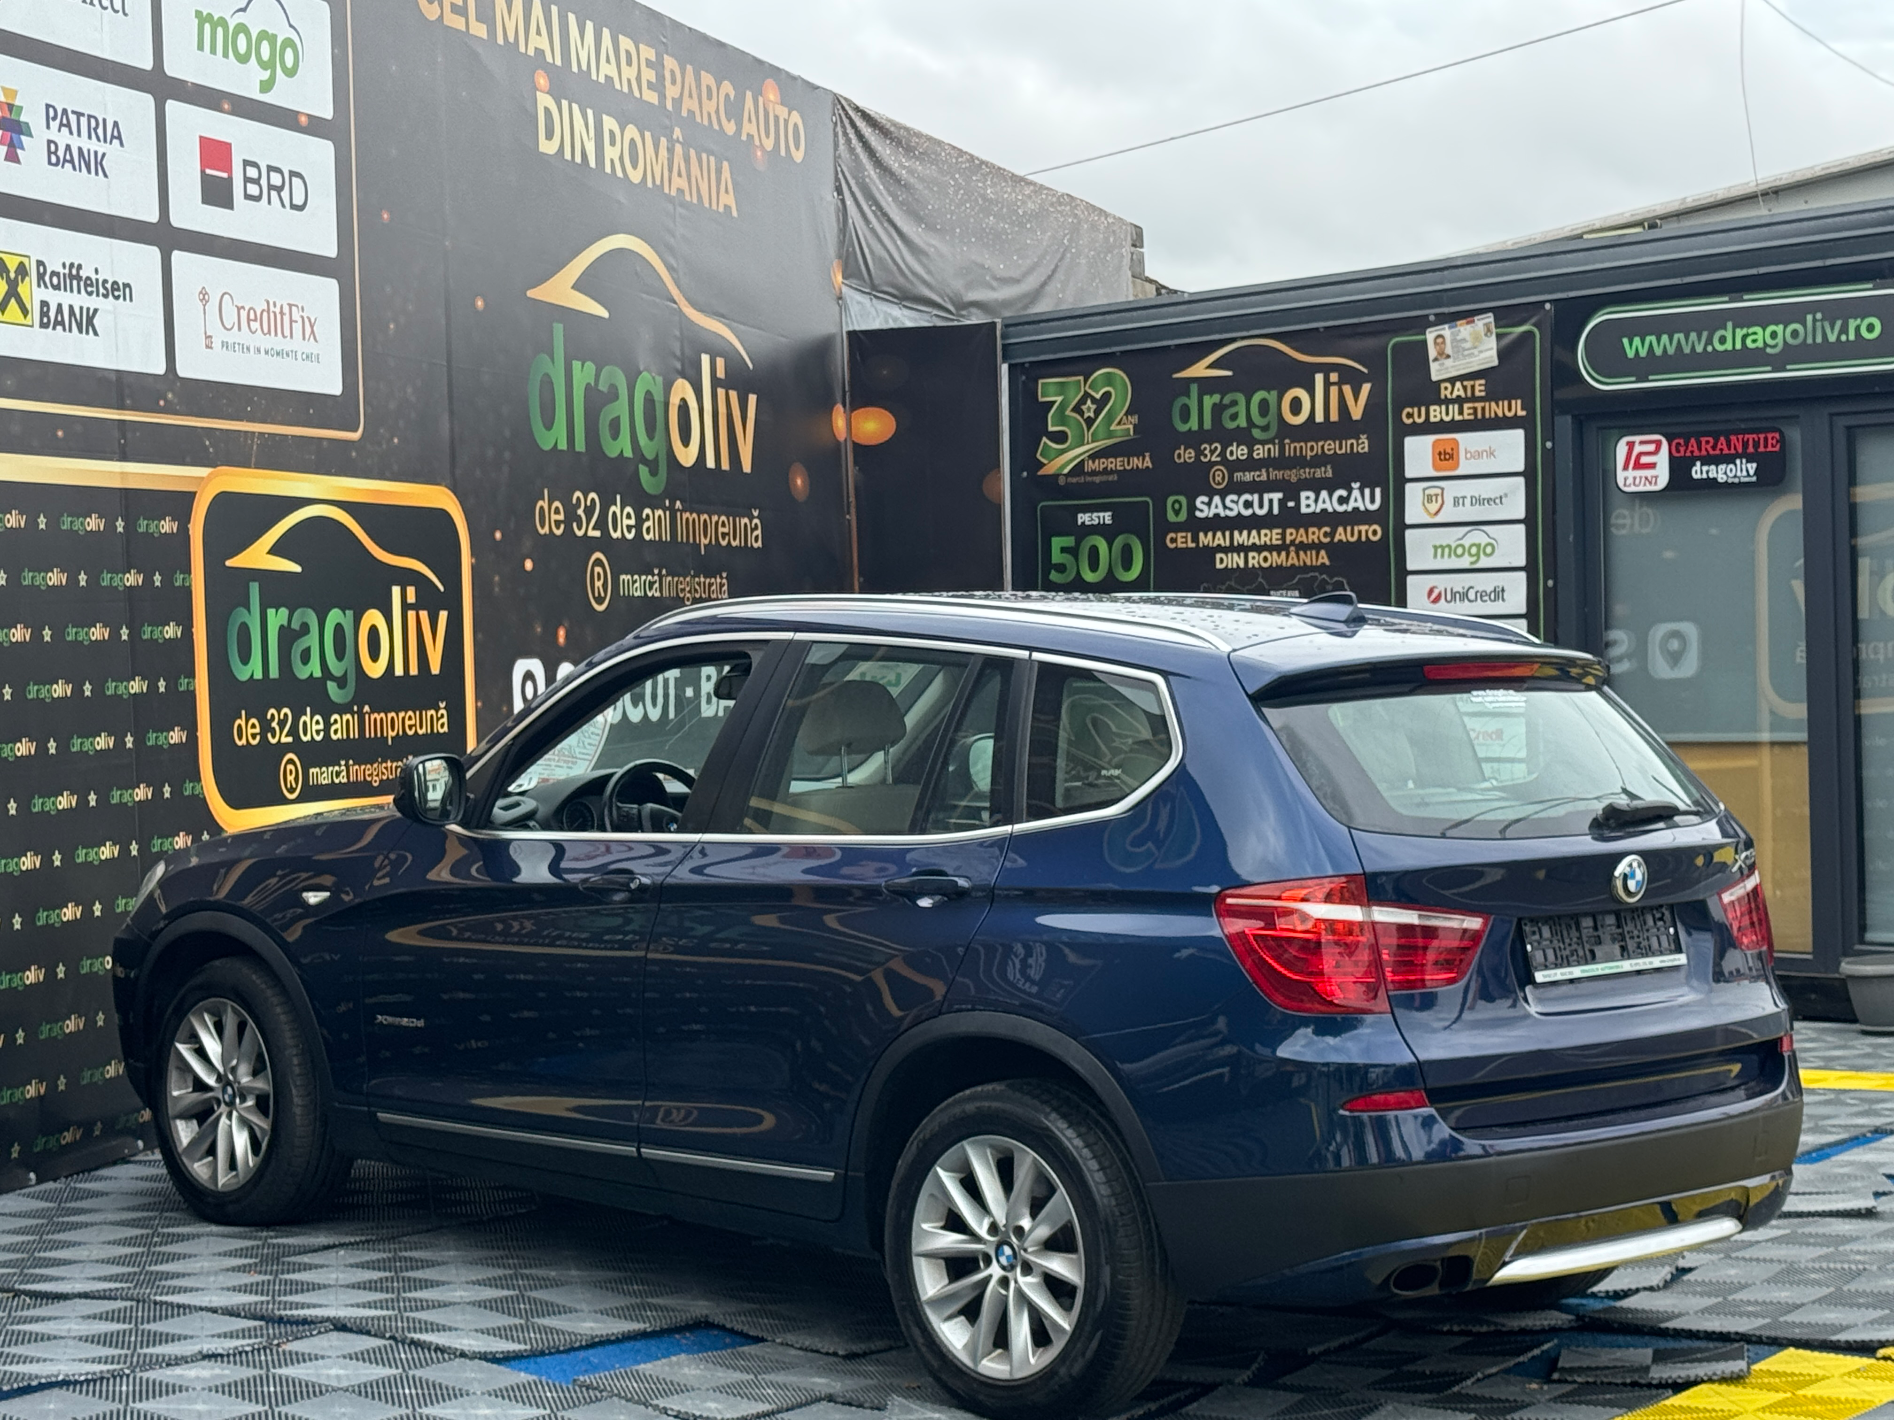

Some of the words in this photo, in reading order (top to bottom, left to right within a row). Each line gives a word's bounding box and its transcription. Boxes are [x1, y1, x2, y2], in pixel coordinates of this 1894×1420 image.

[195, 9, 301, 94] mogo
[495, 0, 562, 67] MAI
[567, 12, 658, 106] MARE
[663, 54, 736, 135] PARC
[741, 90, 806, 164] AUTO
[44, 102, 125, 148] PATRIA
[46, 139, 109, 179] BANK
[536, 90, 596, 169] DIN
[602, 114, 738, 218] ROMÂNIA
[242, 158, 309, 212] BRD
[36, 259, 134, 302] Raiffeisen
[39, 303, 100, 336] BANK
[218, 291, 319, 344] CreditFix
[1621, 312, 1882, 359] www.dragoliv.ro
[220, 339, 251, 355] PRIETEN
[264, 347, 298, 361] MOMENTE
[301, 351, 320, 364] CHEIE
[1440, 379, 1486, 399] RATE
[528, 322, 757, 495] dragoliv
[1036, 367, 1132, 465] 32
[1171, 372, 1372, 440] dragoliv
[1401, 406, 1426, 425] CU
[1429, 399, 1527, 423] BULETINUL
[1174, 445, 1196, 464] de
[1200, 442, 1222, 462] 32
[1226, 442, 1248, 460] de
[1253, 440, 1280, 459] ani
[1284, 434, 1369, 460] împreună
[1437, 447, 1455, 462] tbi
[1464, 446, 1497, 461] bank
[1622, 439, 1662, 472] 12
[1671, 432, 1781, 458] GARANTIE
[1233, 469, 1268, 483] marcă
[1269, 465, 1333, 482] înregistrată
[1623, 476, 1660, 488] LUNI
[1691, 458, 1757, 483] dragoliv
[1194, 493, 1284, 518] SASCUT
[1300, 482, 1382, 514] BACĂU
[1426, 493, 1440, 504] BT
[1453, 496, 1467, 508] BT
[60, 512, 105, 534] dragoliv
[137, 516, 178, 537] dragoliv
[535, 488, 565, 536] de
[572, 490, 601, 538] 32
[608, 494, 636, 540] de
[642, 499, 670, 541] ani
[675, 500, 762, 555] împreună
[1077, 512, 1112, 526] PESTE
[1165, 533, 1196, 549] CEL
[1199, 530, 1230, 547] MAI
[1233, 528, 1282, 546] MARE
[1285, 527, 1331, 544] PARC
[1333, 524, 1382, 543] AUTO
[1049, 533, 1144, 584] 500
[1215, 552, 1245, 569] DIN
[1248, 546, 1330, 568] ROMÂNIA
[1432, 541, 1496, 567] mogo
[21, 567, 67, 590] dragoliv
[100, 569, 143, 590] dragoliv
[173, 570, 192, 589] dra
[619, 568, 661, 597] marcă
[662, 568, 729, 605] înregistrată
[1444, 585, 1506, 604] UniCredit
[65, 623, 110, 645] dragoliv
[141, 621, 182, 643] dragoliv
[227, 581, 449, 704] dragoliv
[26, 679, 72, 702] dragoliv
[105, 676, 148, 698] dragoliv
[178, 675, 195, 691] dra
[233, 710, 261, 746] de
[266, 707, 294, 744] 32
[299, 706, 325, 742] de
[330, 705, 359, 740] ani
[363, 701, 449, 745] împreună
[70, 732, 115, 755] dragoliv
[146, 727, 187, 748] dragoliv
[309, 759, 348, 786] marcă
[349, 755, 413, 787] înregistra
[31, 790, 77, 815] dragoliv
[110, 783, 153, 806] dragoliv
[75, 841, 119, 865] dragoliv
[151, 832, 192, 853] dragoliv
[36, 902, 82, 927] dragoliv
[0, 965, 45, 990] dragoliv
[39, 1014, 85, 1039] dragoliv
[80, 1059, 125, 1085] dragoliv
[34, 1126, 83, 1153] dragoliv
